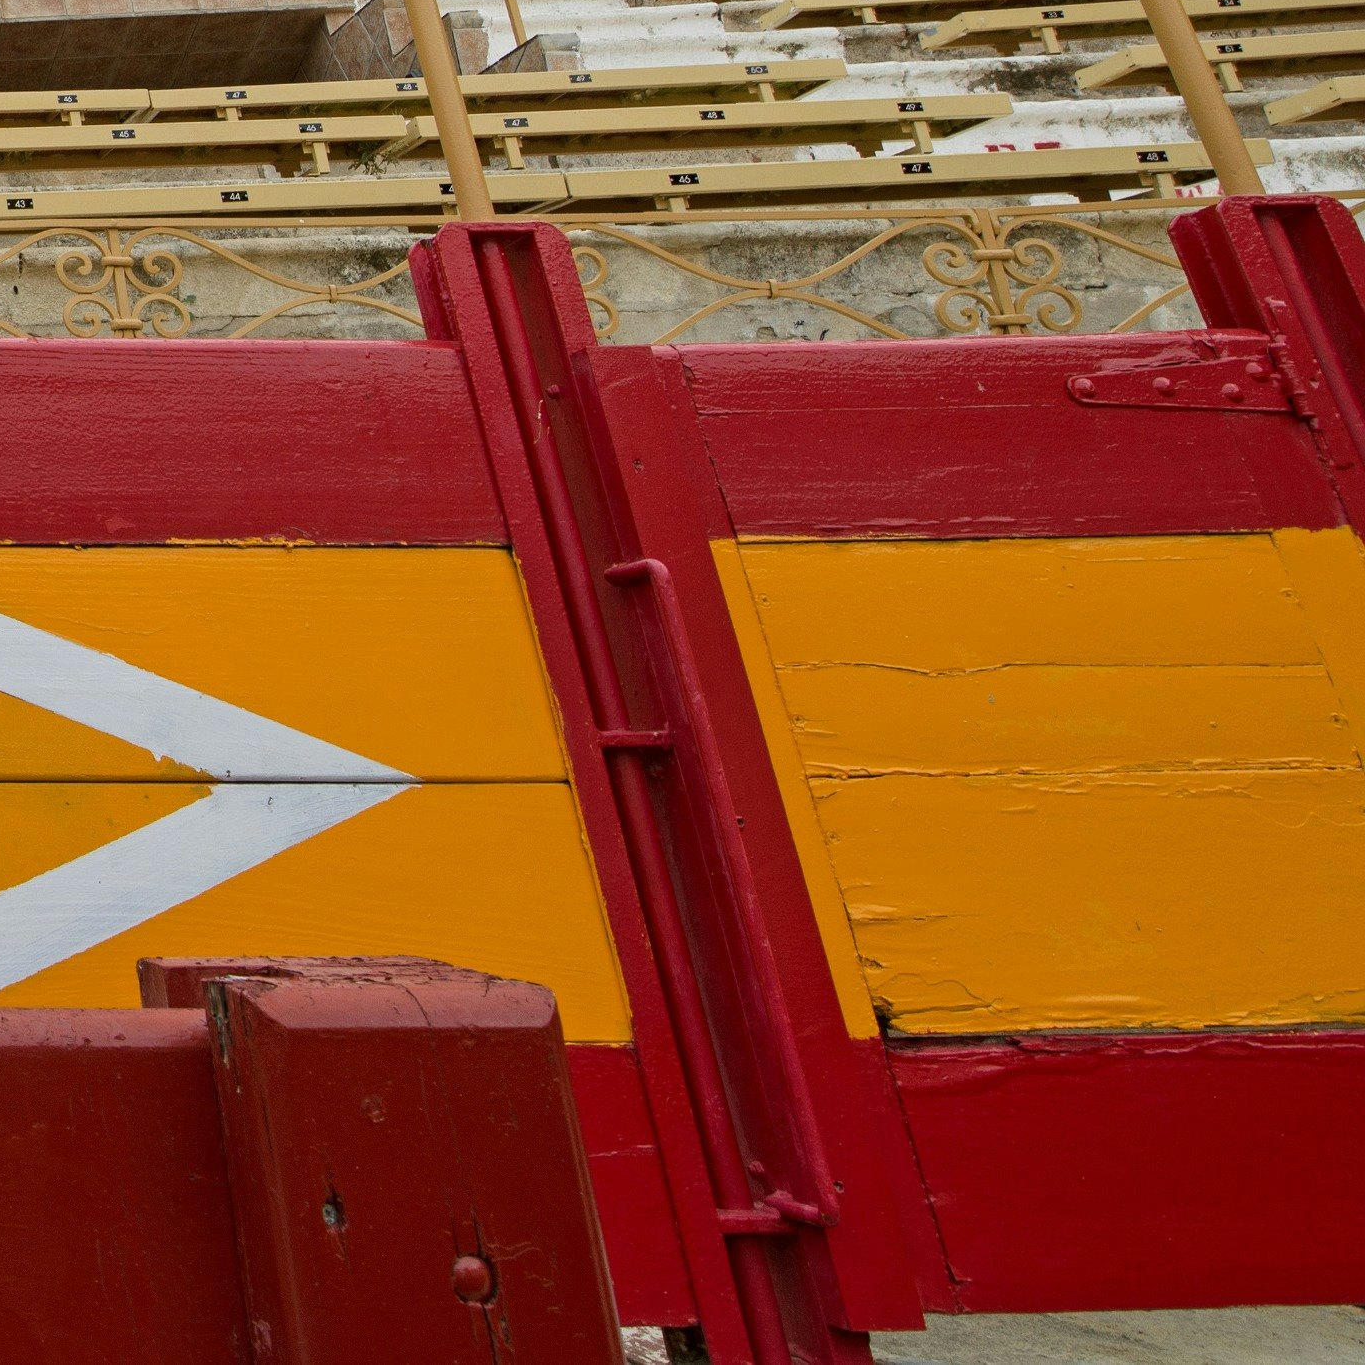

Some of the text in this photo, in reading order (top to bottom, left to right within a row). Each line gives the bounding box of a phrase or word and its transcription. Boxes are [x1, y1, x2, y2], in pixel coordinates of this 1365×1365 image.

[904, 103, 917, 111] 49
[706, 111, 718, 119] 48
[510, 119, 522, 127] 47
[1145, 152, 1160, 162] 48
[910, 163, 924, 173] 47
[677, 174, 691, 184] 46
[228, 192, 241, 201] 44
[14, 199, 26, 208] 43
